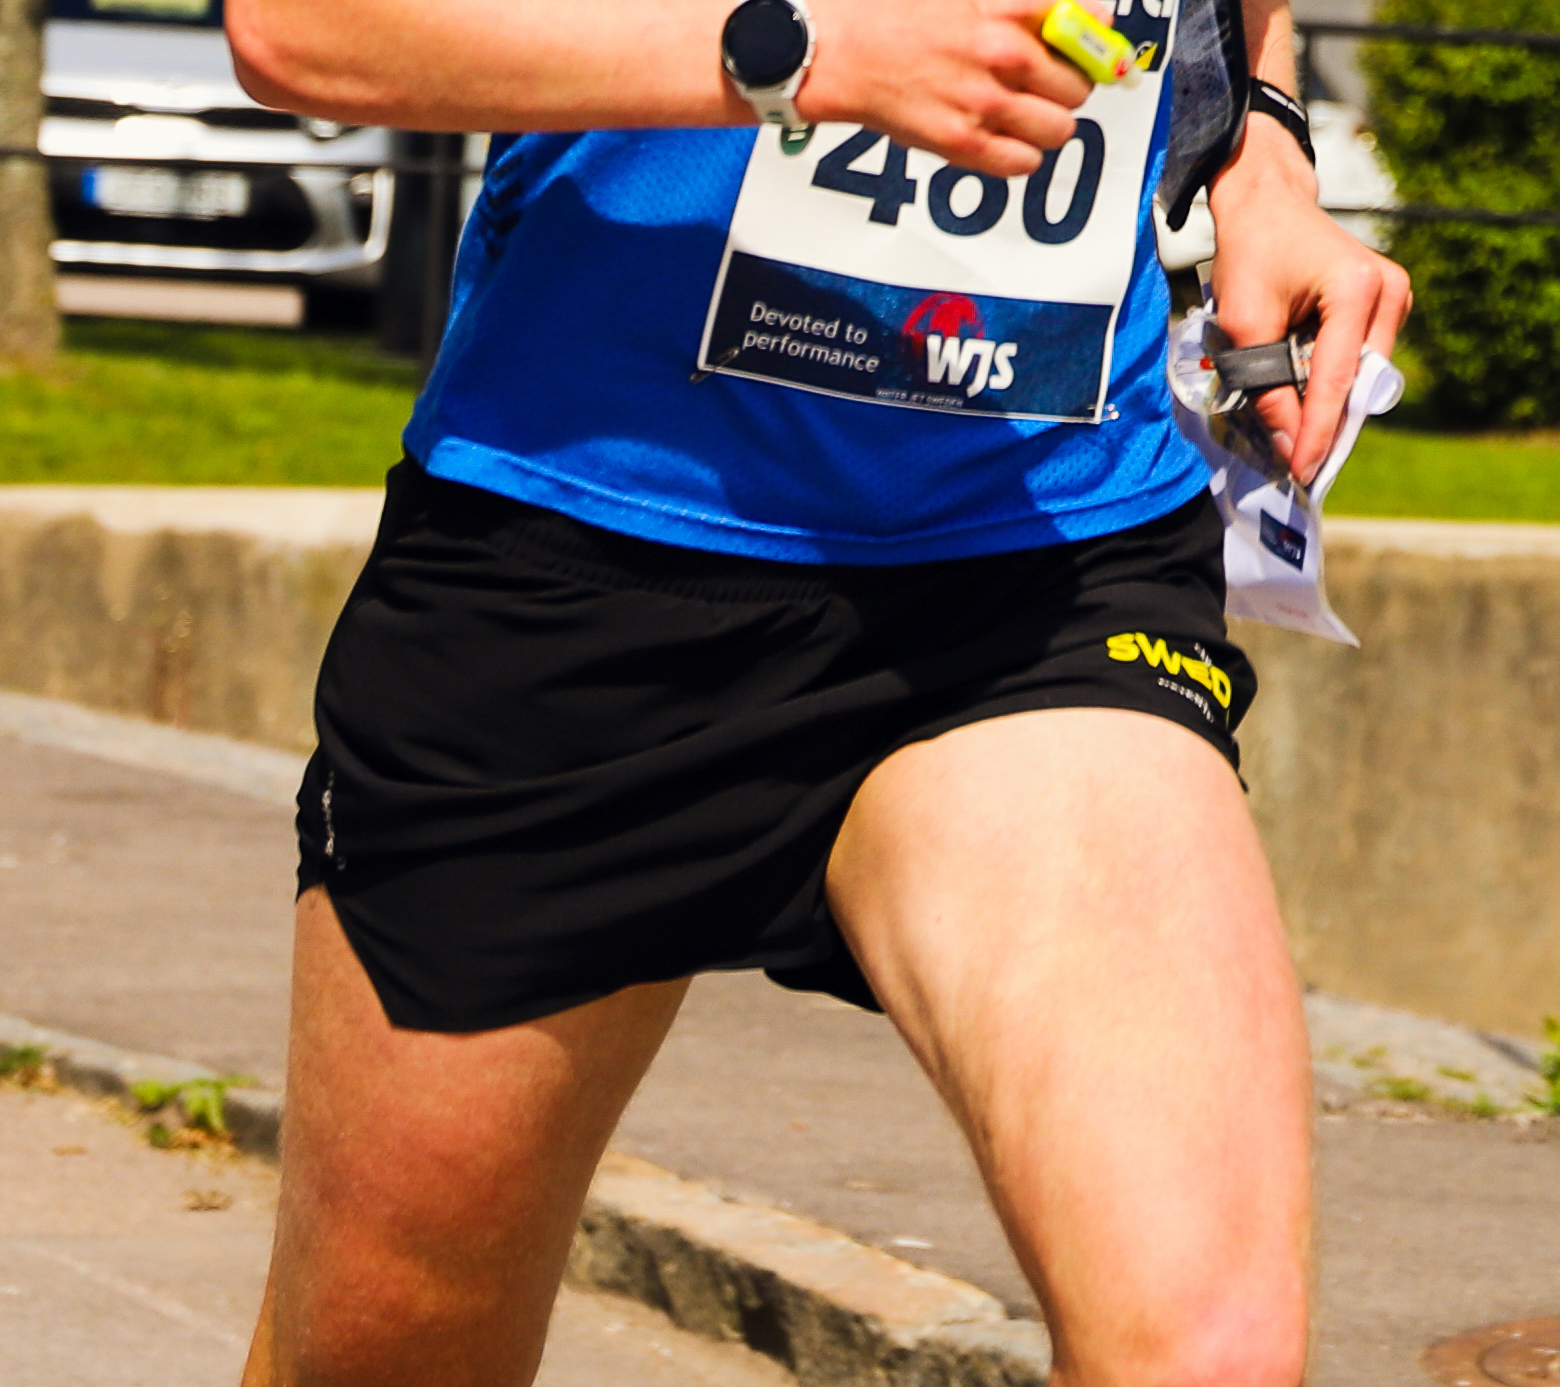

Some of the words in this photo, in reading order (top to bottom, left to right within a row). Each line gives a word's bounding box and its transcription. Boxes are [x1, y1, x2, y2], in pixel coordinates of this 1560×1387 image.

[750, 301, 841, 339] Devoted
[845, 323, 868, 345] to
[742, 330, 880, 373] performance
[926, 334, 1018, 398] WJS
